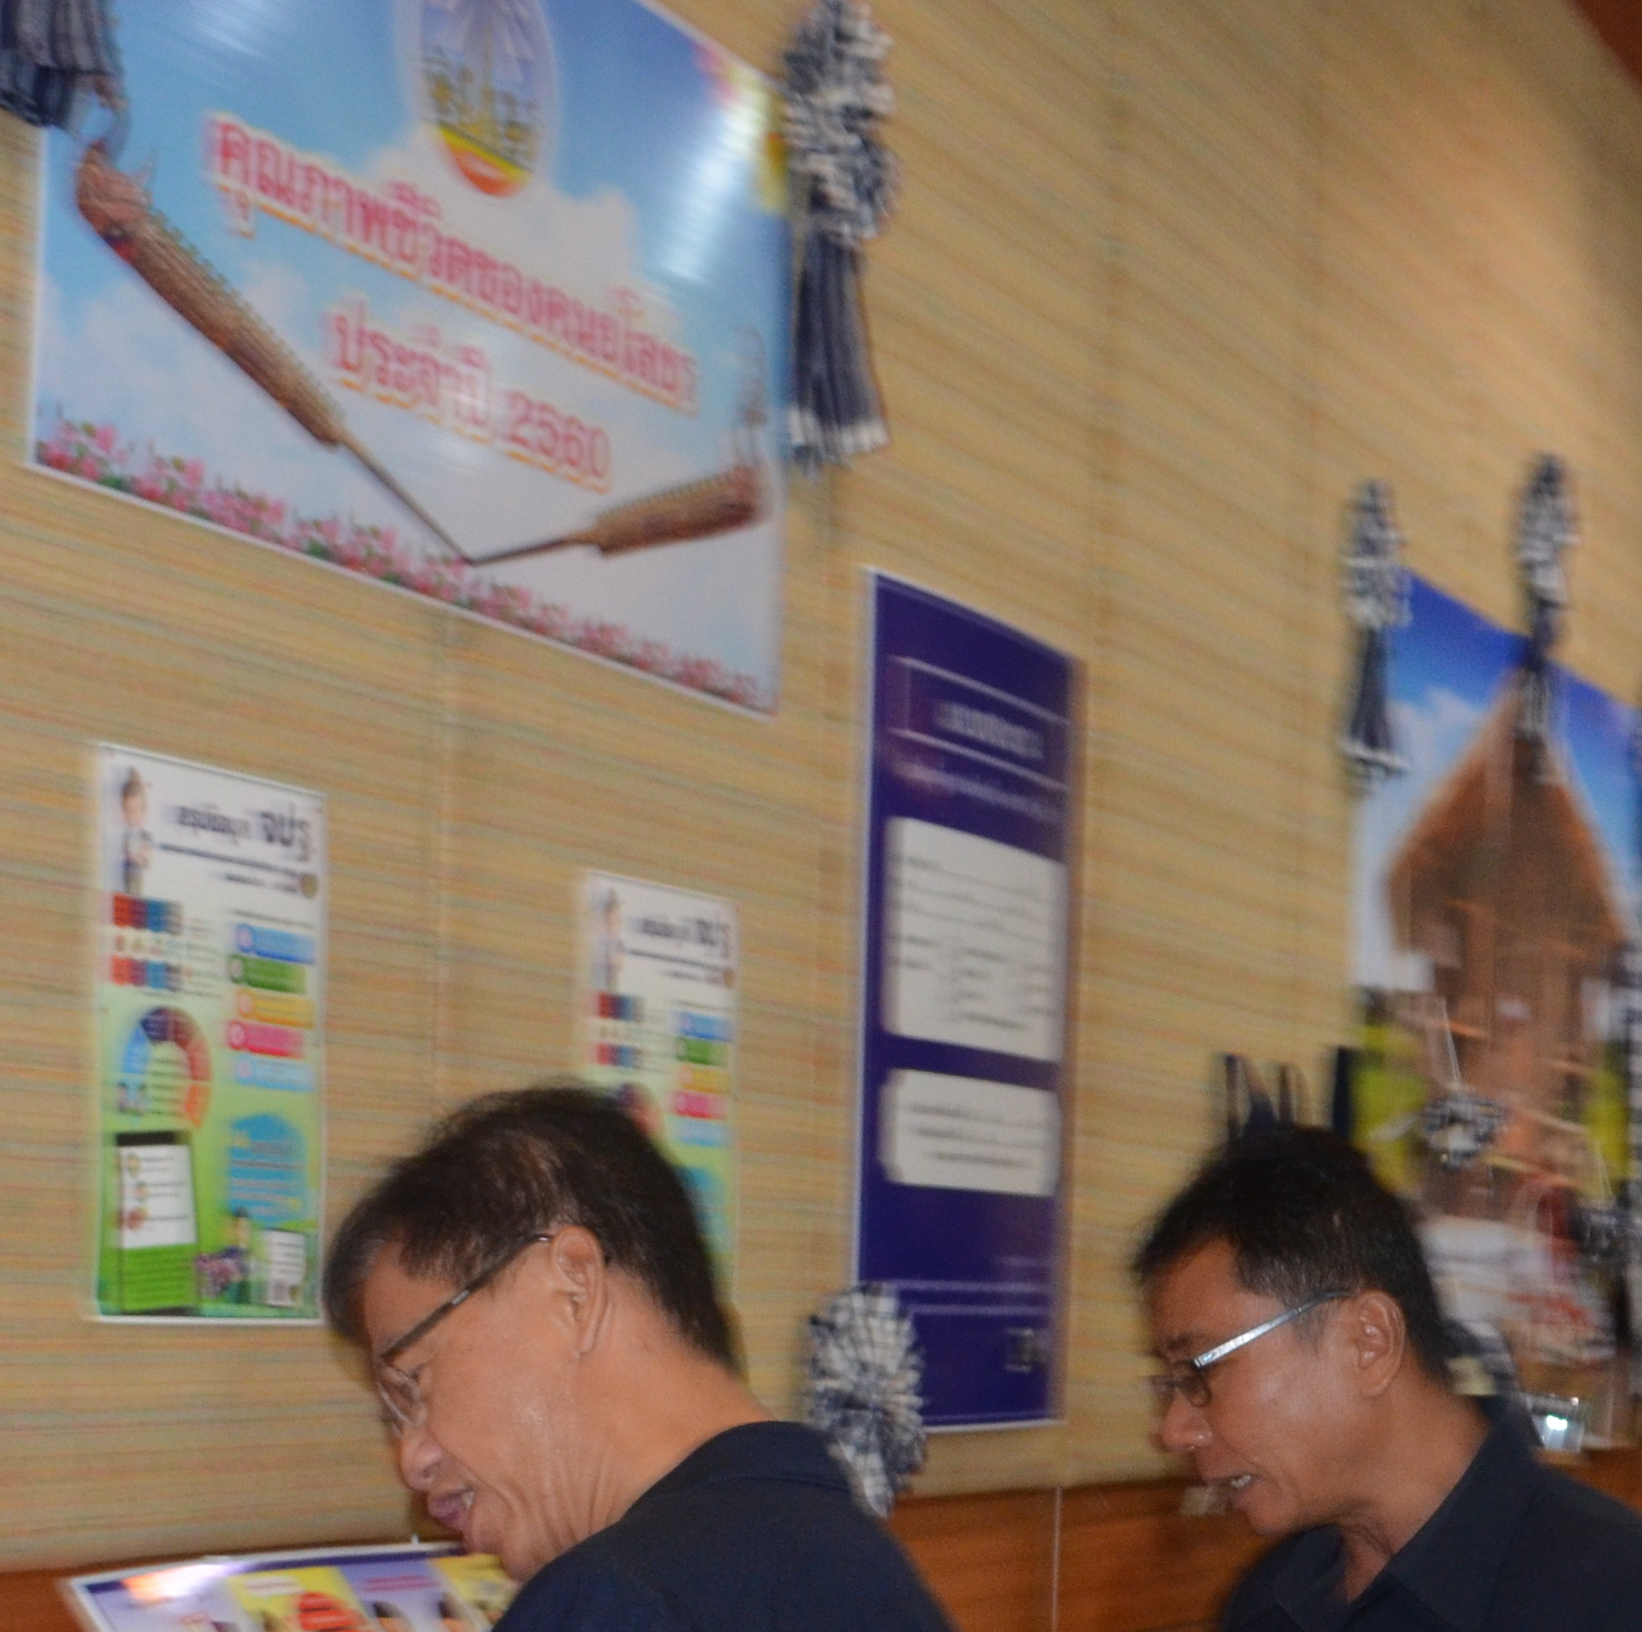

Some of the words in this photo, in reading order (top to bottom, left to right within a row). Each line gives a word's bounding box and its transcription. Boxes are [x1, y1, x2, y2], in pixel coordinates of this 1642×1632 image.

[211, 115, 701, 412] คุณภาพชีวิตของคนยโสธร
[324, 294, 493, 442] ประจำปี
[501, 388, 612, 492] 2560
